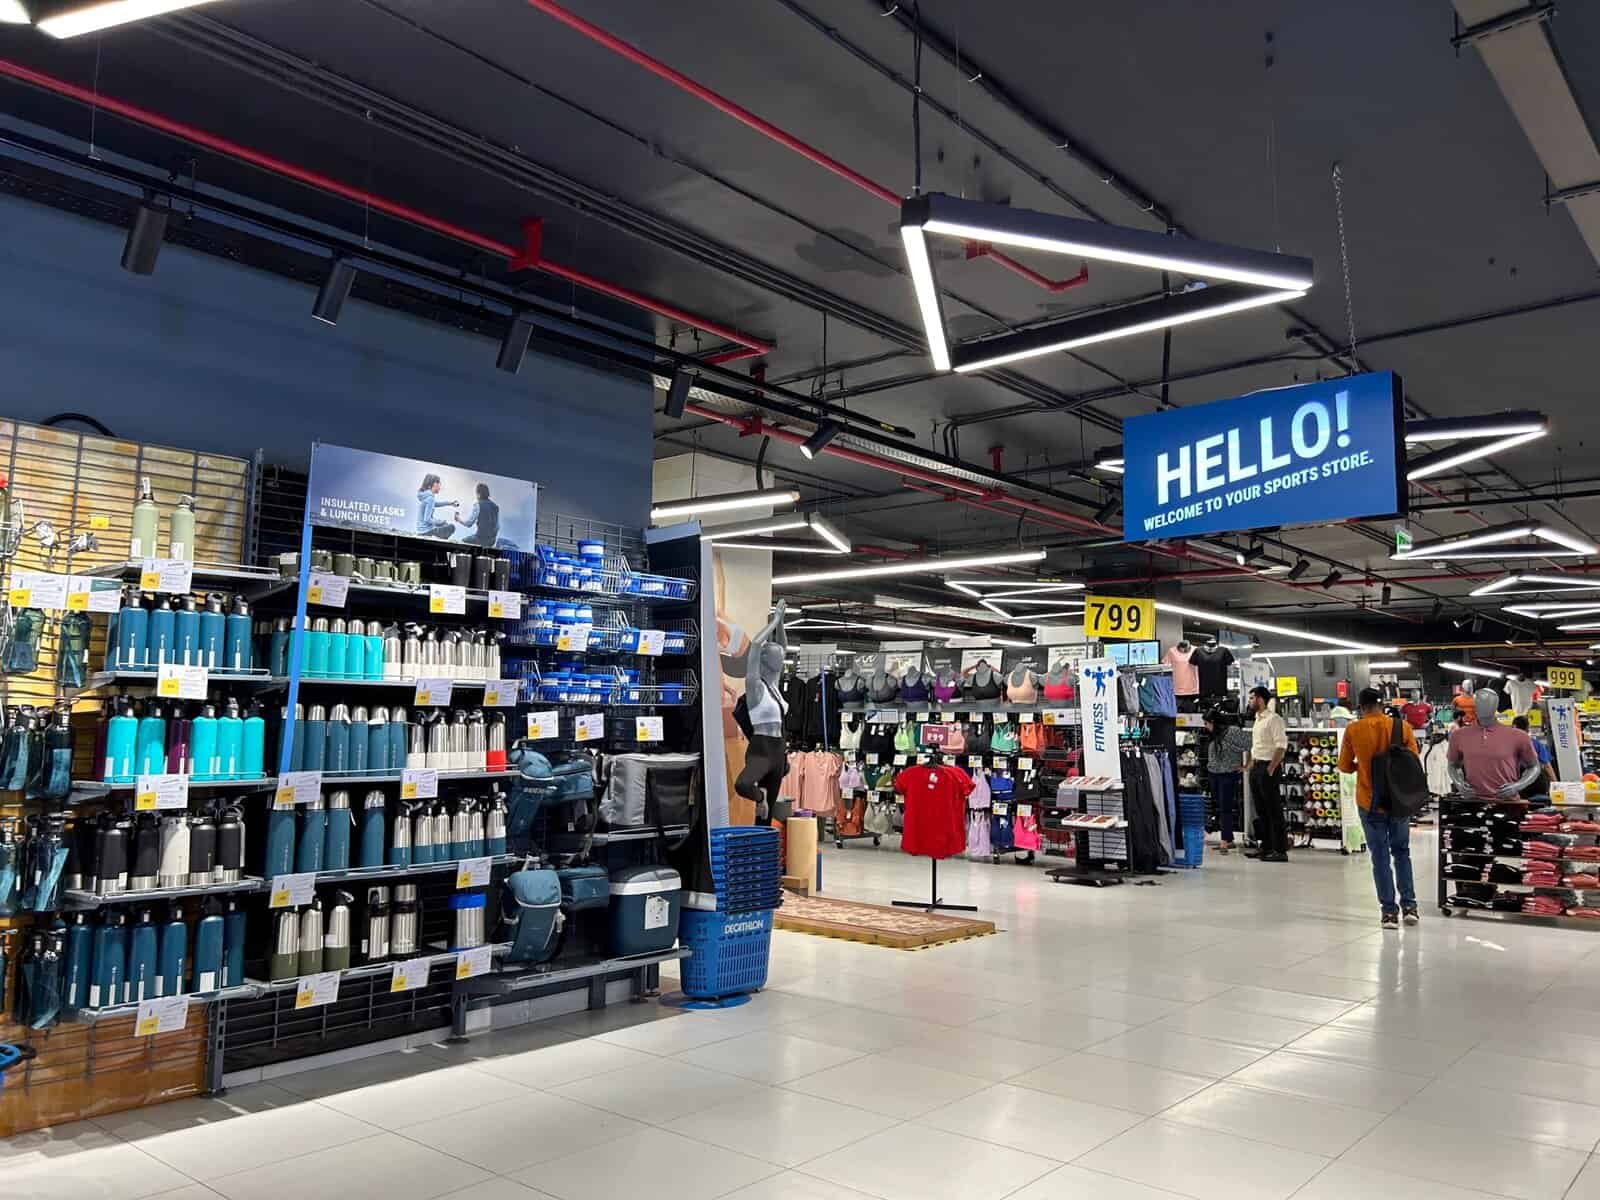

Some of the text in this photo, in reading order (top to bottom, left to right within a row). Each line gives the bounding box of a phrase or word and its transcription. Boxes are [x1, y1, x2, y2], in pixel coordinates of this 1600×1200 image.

[1157, 390, 1352, 505] HELLO!
[1144, 450, 1374, 532] WELCOME TO YOUR SPORTS STORE.
[320, 496, 406, 518] INSULATED FLASKS
[320, 507, 327, 517] &
[329, 510, 360, 521] LUNCH
[1091, 603, 1141, 632] 799
[1550, 670, 1576, 686] 999
[1093, 703, 1106, 752] FITNESS
[724, 919, 764, 935] DECATHLON
